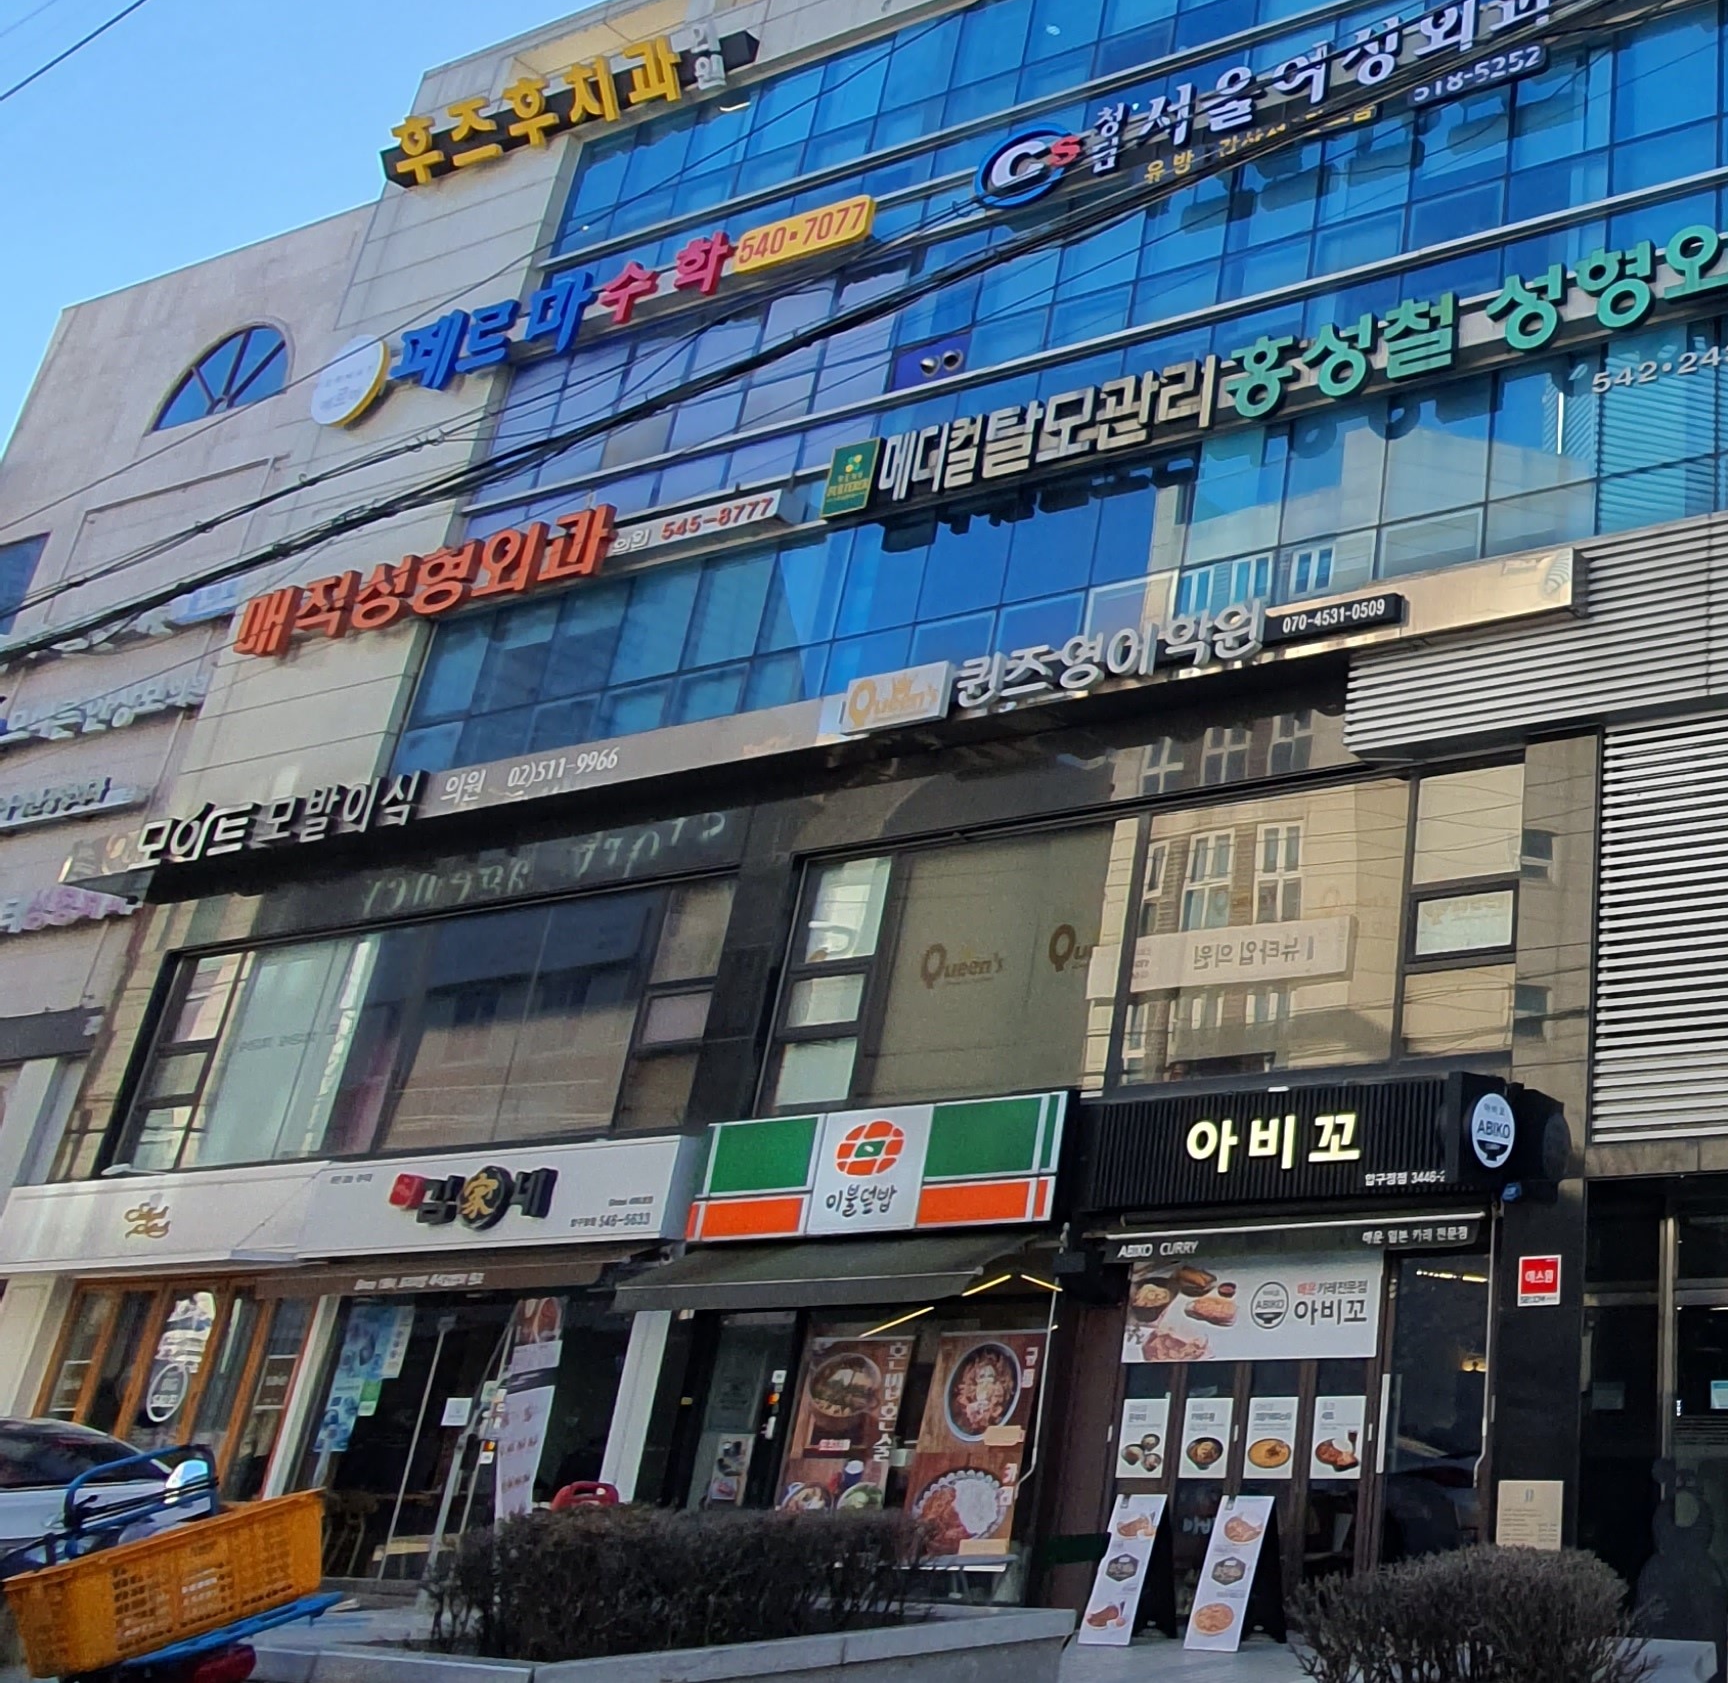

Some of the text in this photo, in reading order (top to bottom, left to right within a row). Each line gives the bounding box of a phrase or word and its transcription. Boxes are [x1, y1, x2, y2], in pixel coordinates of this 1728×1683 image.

[391, 35, 682, 185] 후즈후치과
[1227, 290, 1459, 421] 홍성철
[232, 505, 618, 657] 매직성형외과
[660, 498, 775, 541] 545-8777
[956, 598, 1386, 710] 퀸즈영어학원 070-4531-0509
[264, 770, 422, 845] 모발이식
[440, 770, 488, 806] 의원
[505, 747, 620, 790] 02)511-9966
[1185, 1110, 1362, 1174] 아비꼬
[1476, 1119, 1512, 1140] ABIKO
[1293, 1298, 1368, 1326] 아비꼬
